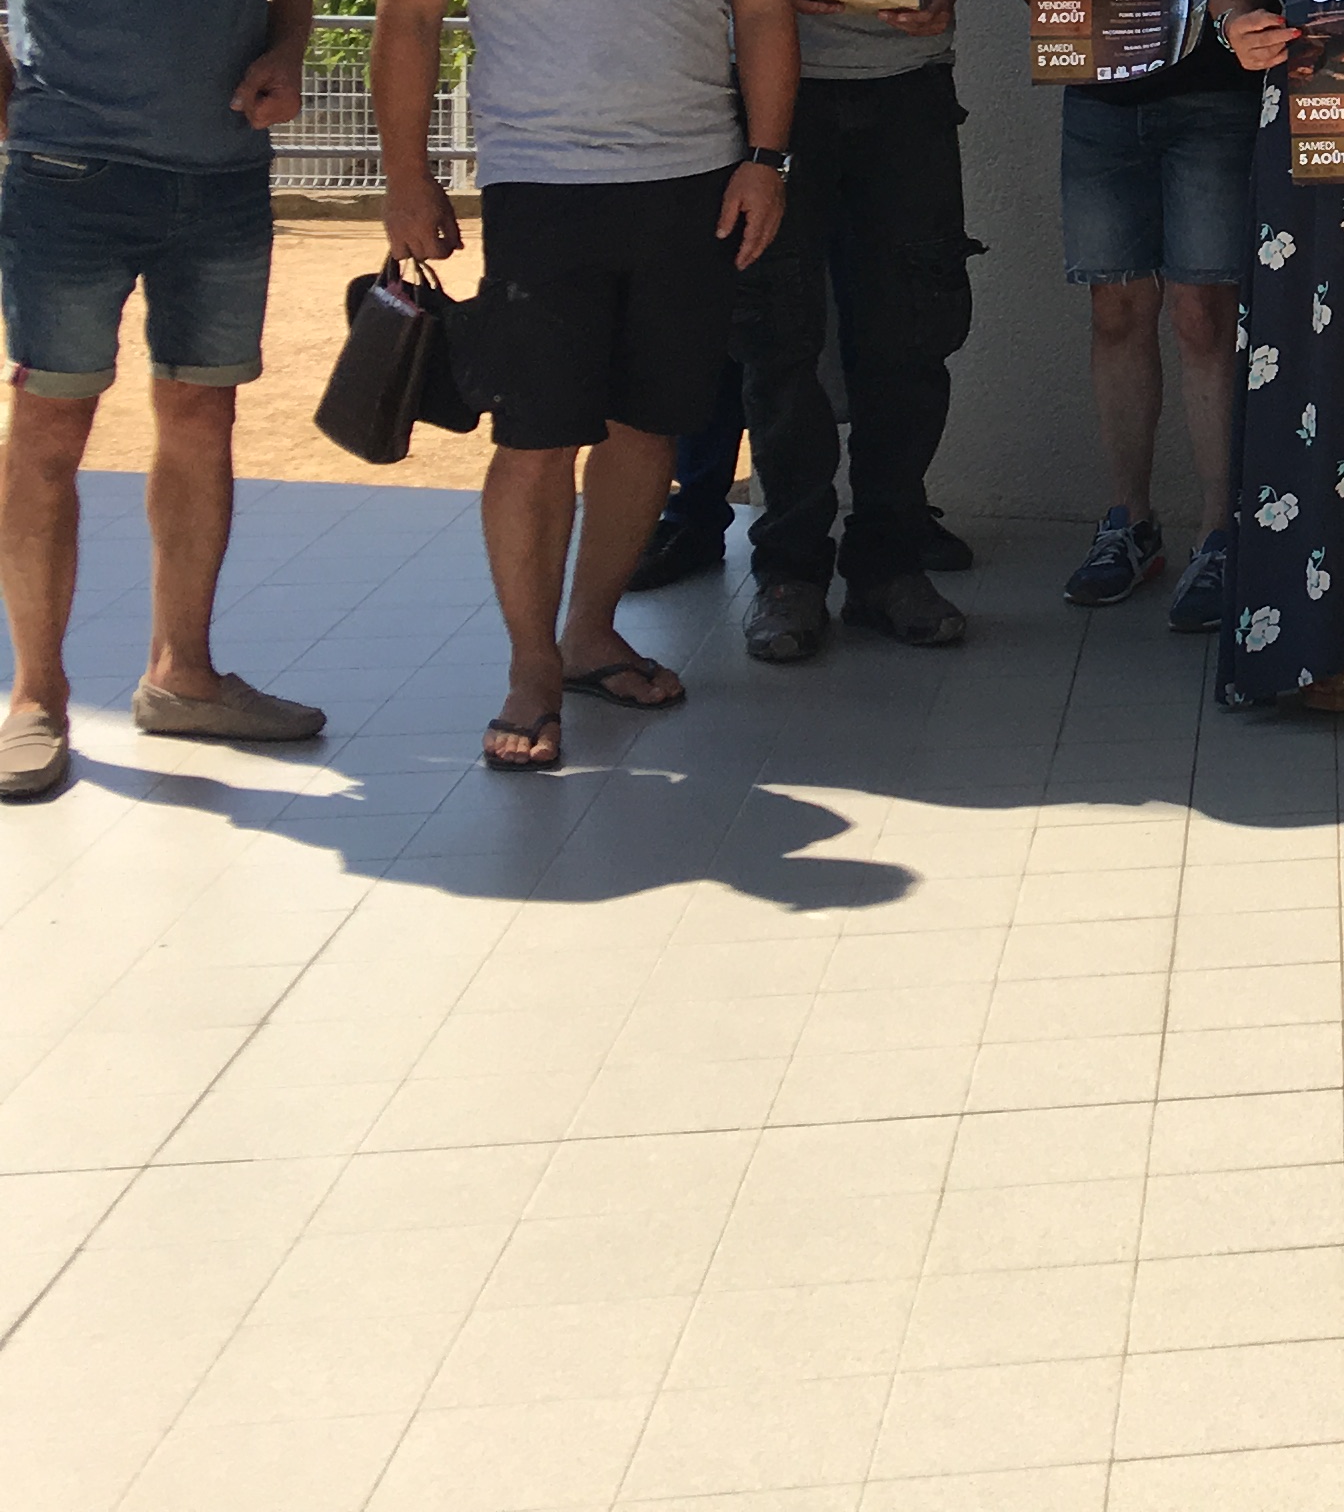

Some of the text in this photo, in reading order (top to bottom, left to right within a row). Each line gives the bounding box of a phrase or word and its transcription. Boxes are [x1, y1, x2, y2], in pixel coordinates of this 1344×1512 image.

[1037, 0, 1081, 10] VENDREDI
[1037, 10, 1086, 24] 4 AOÛT
[1037, 43, 1073, 53] SAMEDI
[1037, 52, 1086, 67] 5 AOÛT
[1296, 97, 1341, 107] VENDREDI
[1297, 109, 1308, 121] 4
[1298, 141, 1335, 151] SAMEDI
[1299, 153, 1309, 165] 5
